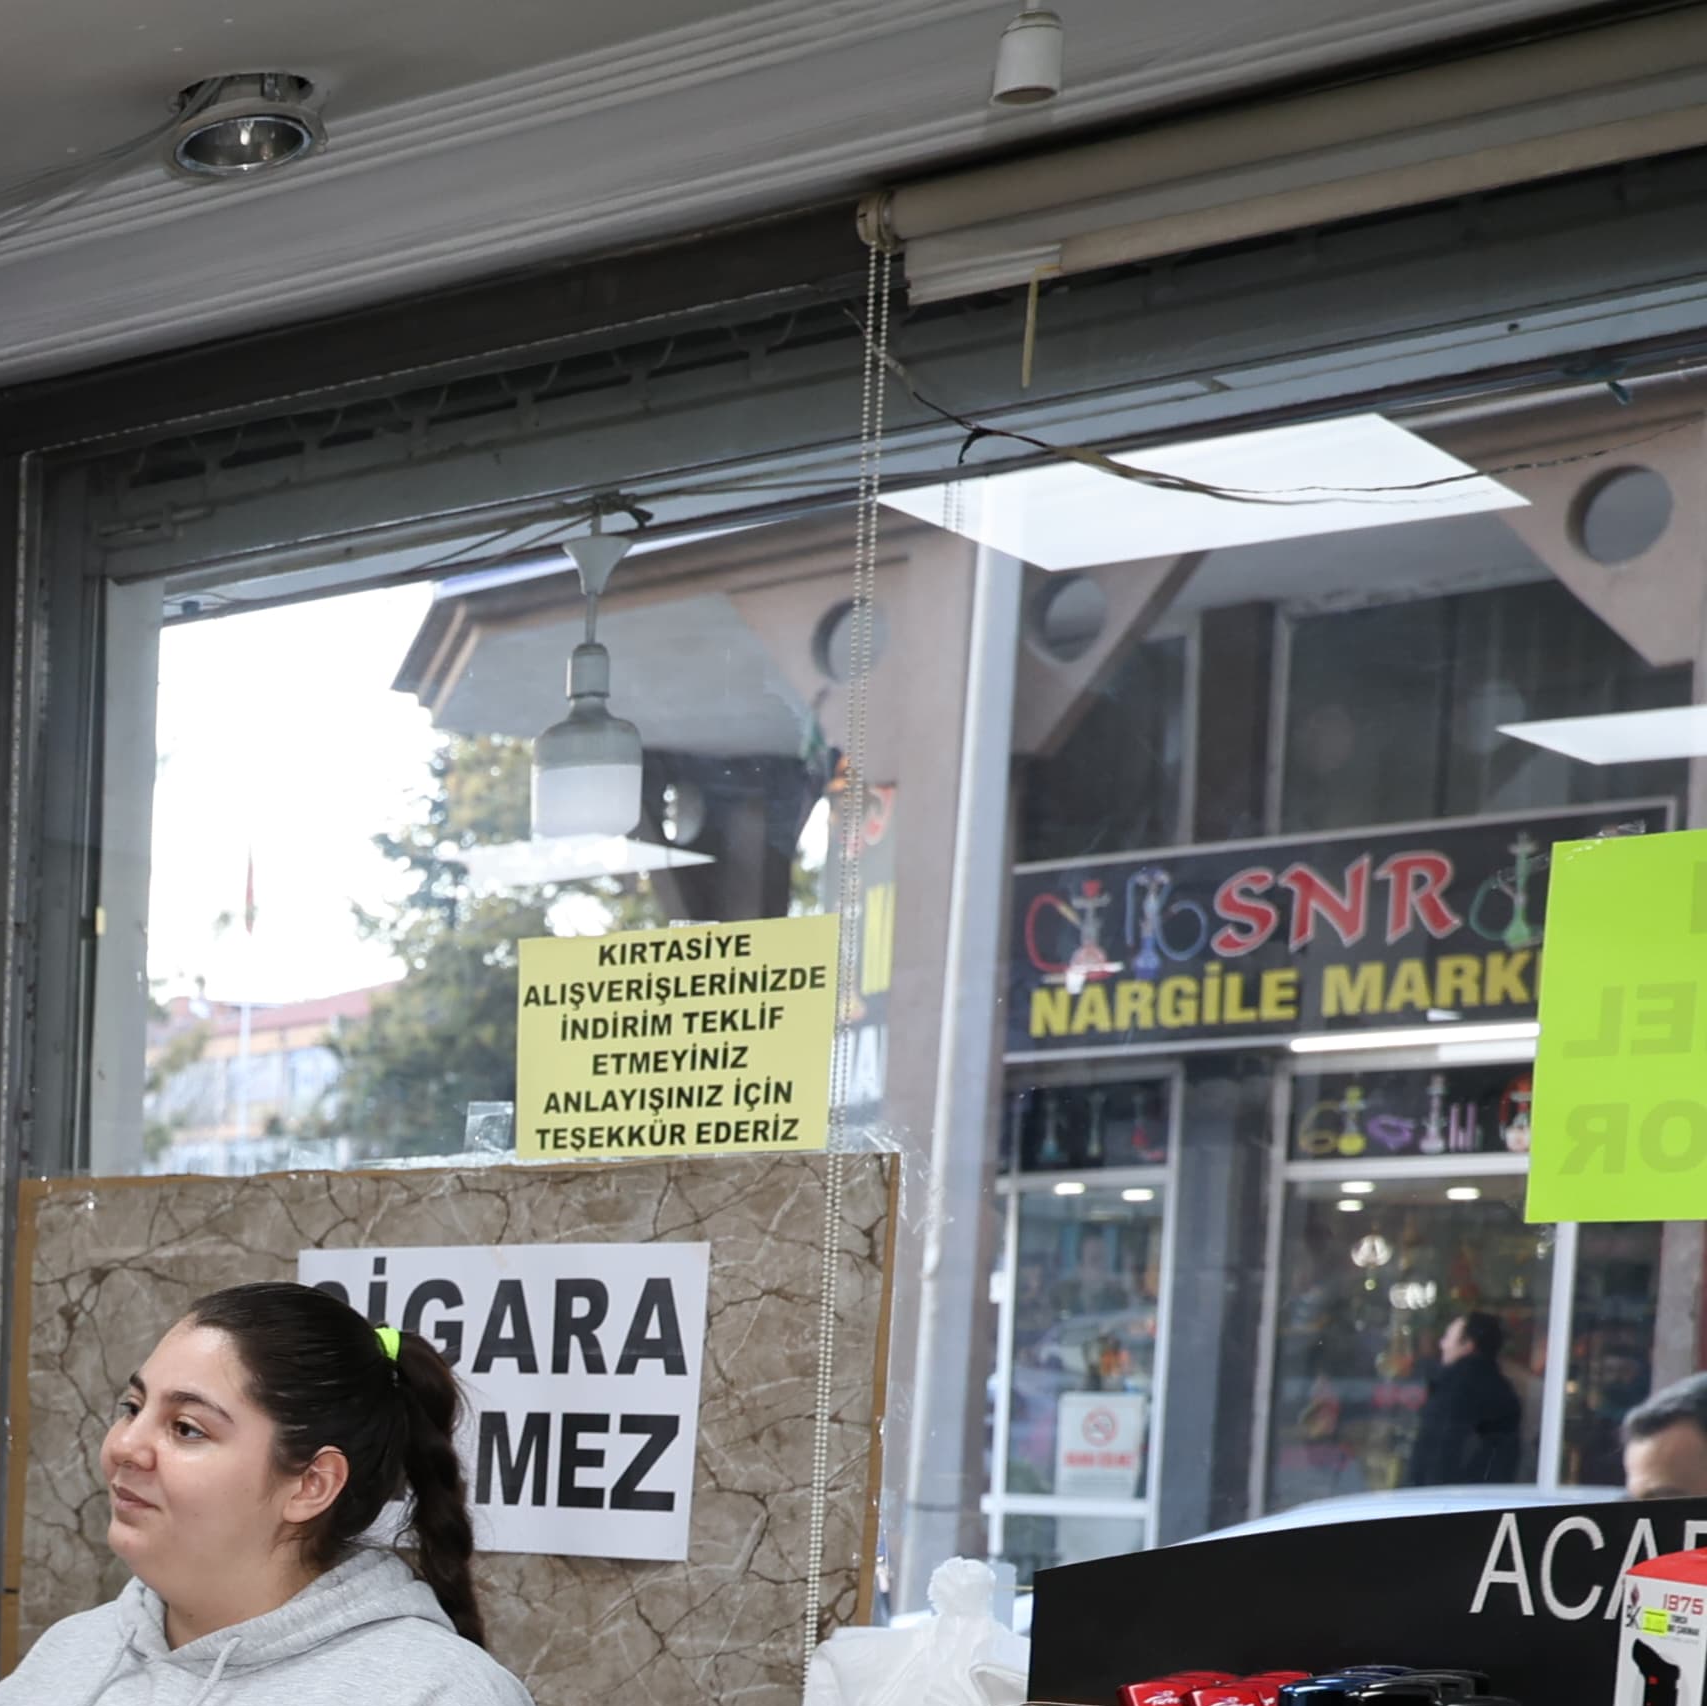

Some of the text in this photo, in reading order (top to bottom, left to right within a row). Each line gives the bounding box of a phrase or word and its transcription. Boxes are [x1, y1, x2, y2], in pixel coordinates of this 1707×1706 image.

[1212, 849, 1462, 956] SNR
[598, 932, 752, 969] KIRTASİYE
[523, 963, 826, 1011] ALIŞVERİŞLERİNİZDE
[1029, 952, 1541, 1039] NARGİLE MARK
[559, 1003, 785, 1042] İNDİRİM TEKLİF
[591, 1043, 750, 1078] ETMEYİNİZ
[544, 1078, 793, 1120] ANLAYIŞINIZ İÇİN
[535, 1114, 800, 1158] TEŞEKKÜR EDERİZ
[1468, 1511, 1707, 1621] ACA
